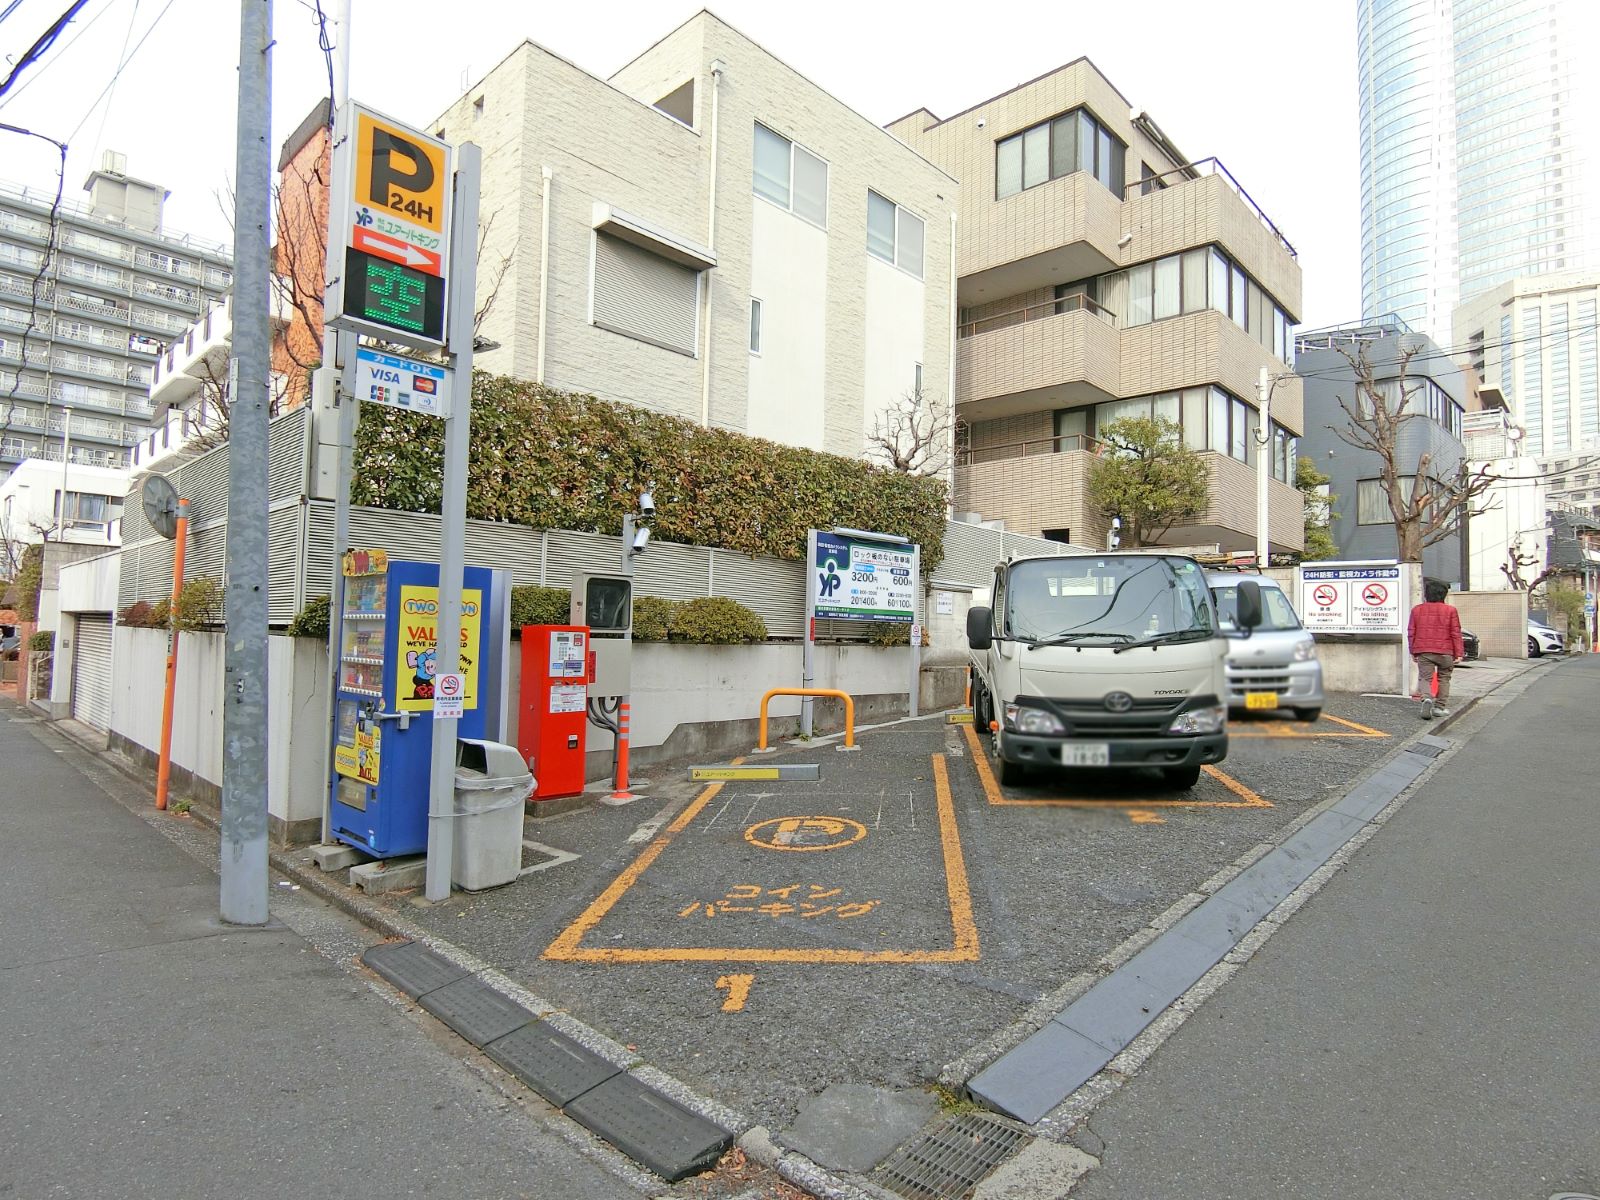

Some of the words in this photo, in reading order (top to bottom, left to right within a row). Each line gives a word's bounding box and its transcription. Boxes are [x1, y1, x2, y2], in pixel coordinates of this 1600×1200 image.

[370, 126, 434, 207] P
[390, 193, 433, 223] 24H
[365, 266, 425, 331] 空
[369, 367, 400, 384] VISA
[726, 884, 841, 899] コイン
[678, 900, 880, 918] パーキング
[715, 973, 756, 1012] 1
